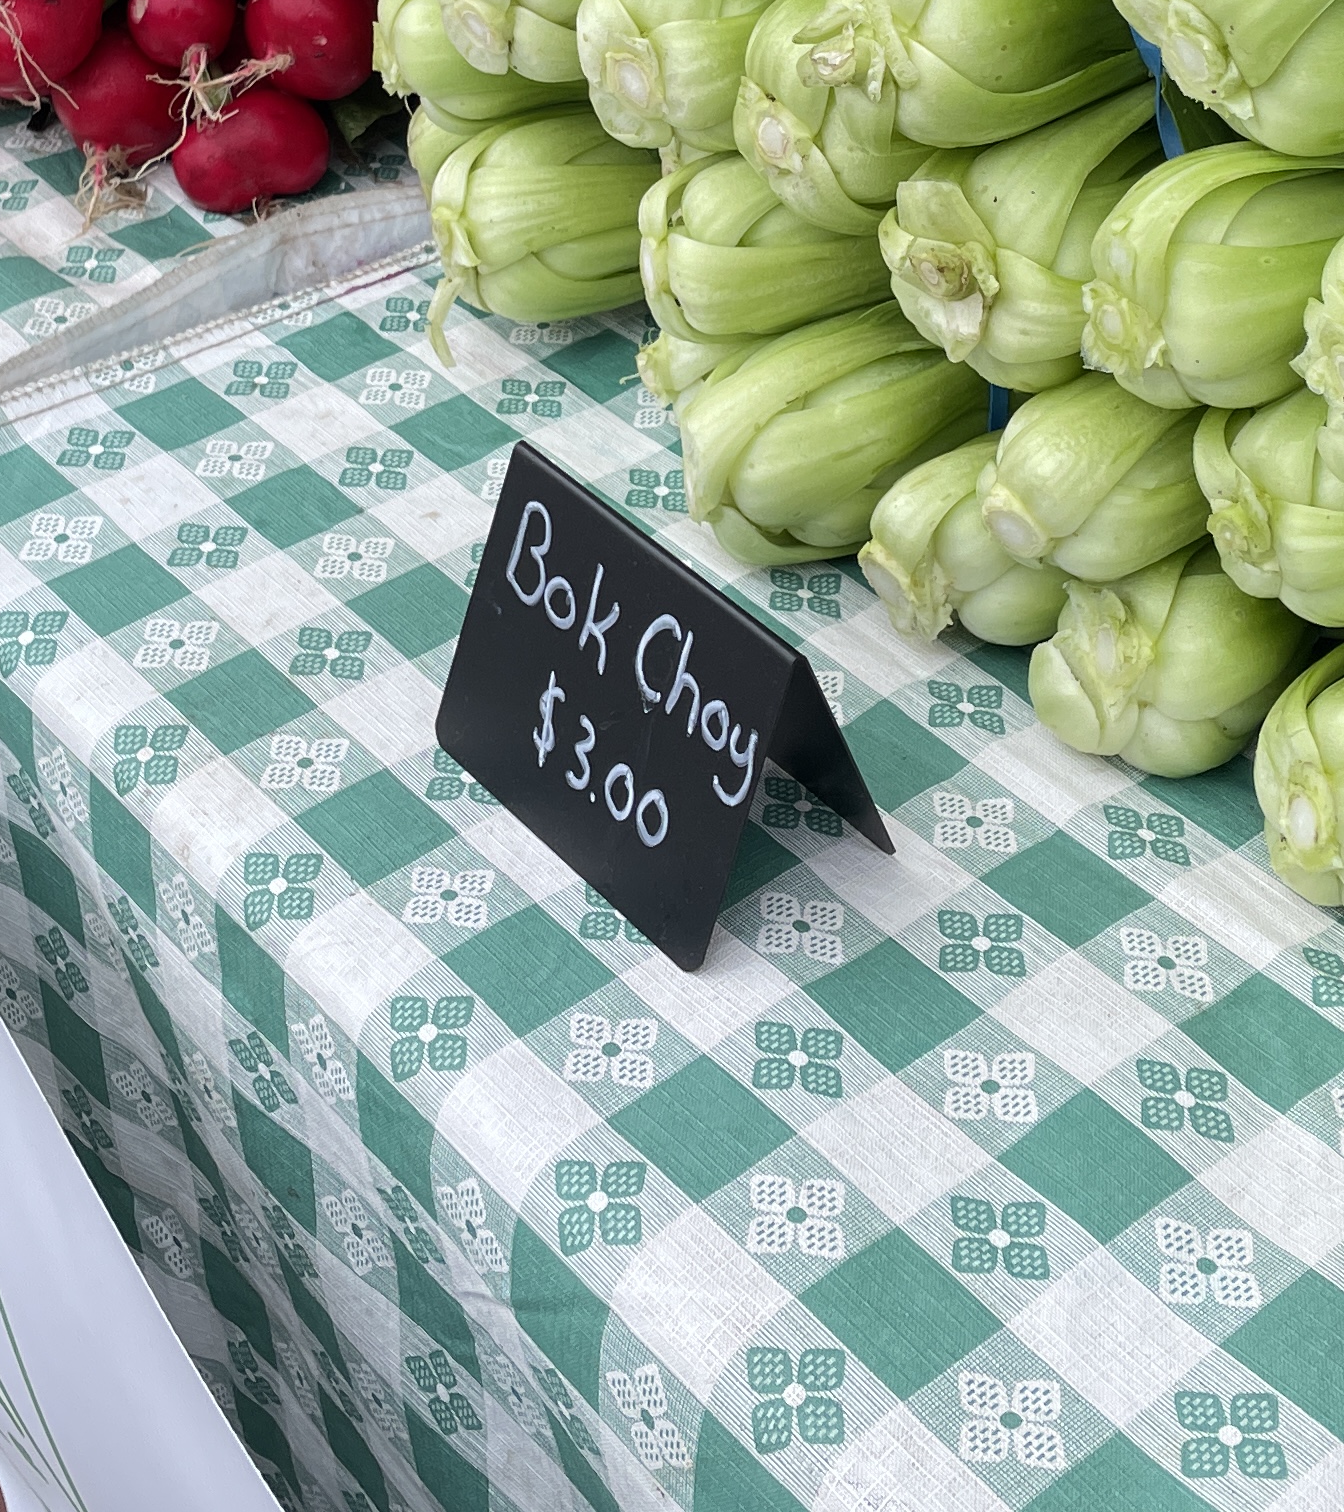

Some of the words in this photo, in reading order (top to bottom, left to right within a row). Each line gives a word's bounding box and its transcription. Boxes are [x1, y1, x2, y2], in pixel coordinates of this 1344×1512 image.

[507, 500, 621, 676] Bok
[634, 613, 759, 807] Choy
[532, 670, 670, 848] $3.00
